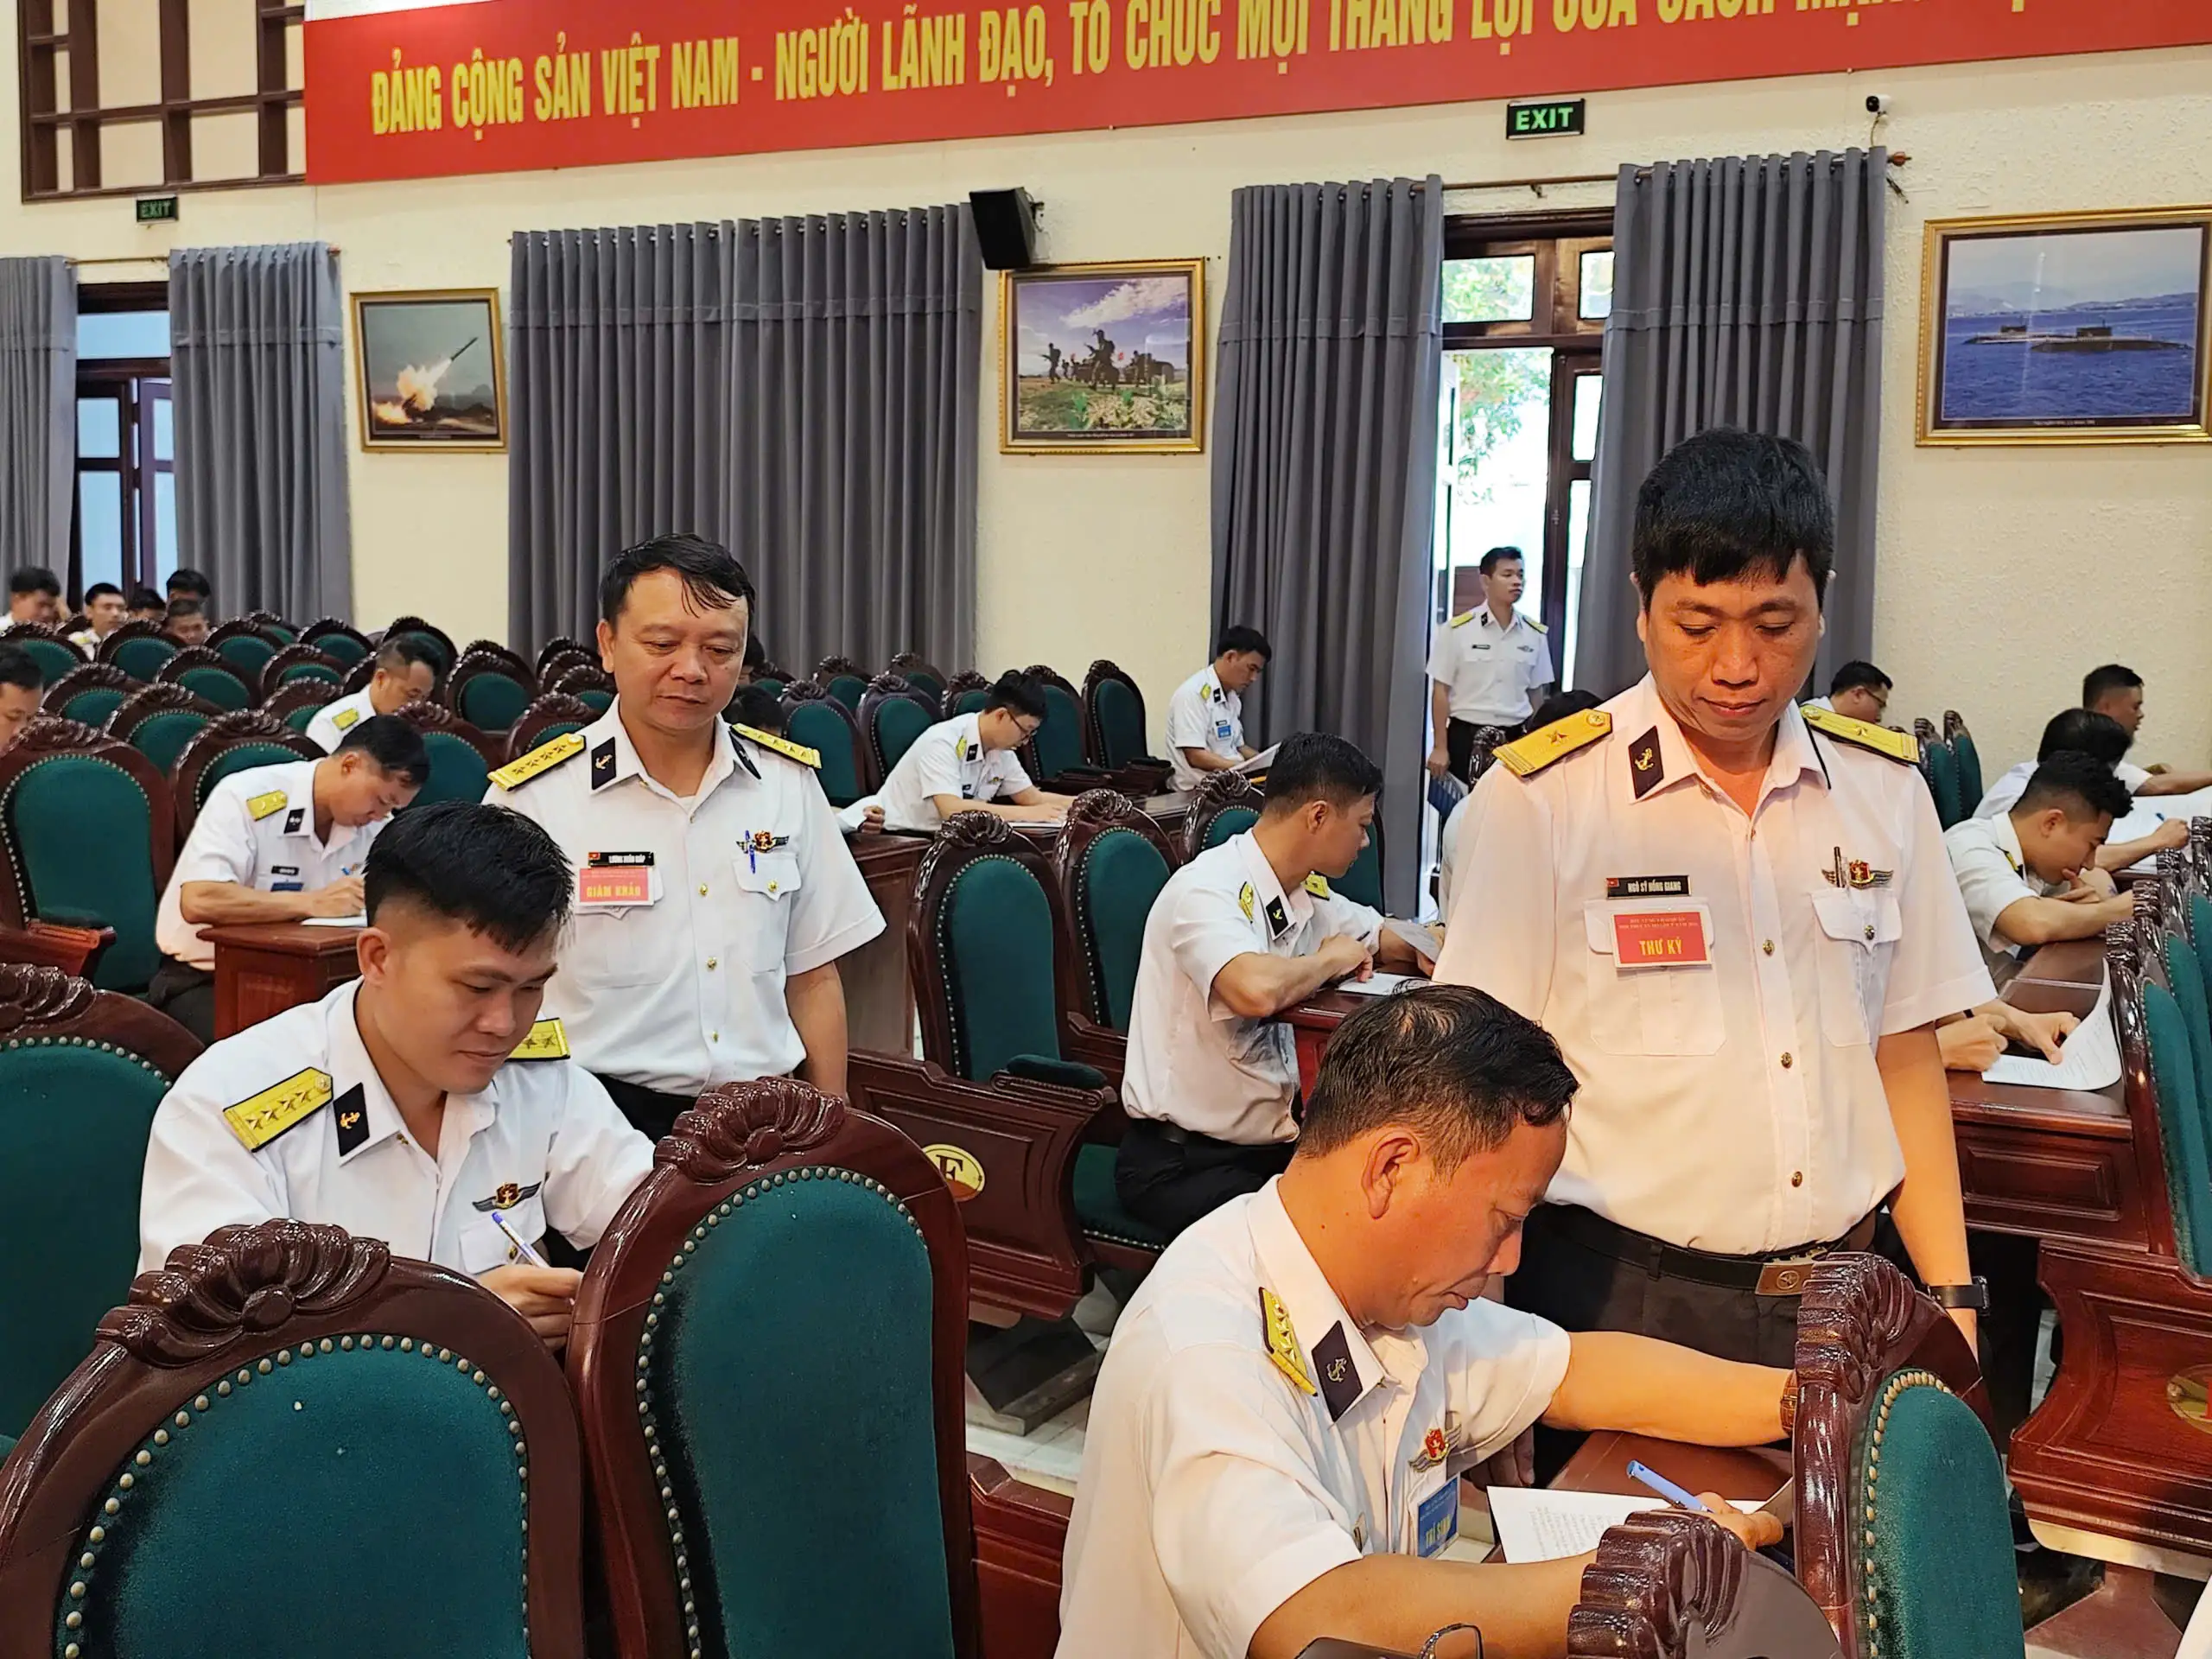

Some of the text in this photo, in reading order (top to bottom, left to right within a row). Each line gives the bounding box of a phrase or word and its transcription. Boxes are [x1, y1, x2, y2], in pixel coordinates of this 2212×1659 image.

[372, 47, 442, 135] ĐẢNG
[452, 48, 524, 141] CỘNG
[534, 32, 591, 122] SẢN
[601, 32, 660, 129] VIỆT
[671, 36, 739, 110] NAM
[775, 7, 869, 100] NGƯỜI
[881, 3, 965, 91] LÃNH
[978, 4, 1053, 97] ĐẠO,
[1516, 107, 1574, 130] EXIT
[140, 201, 171, 217] EXIT
